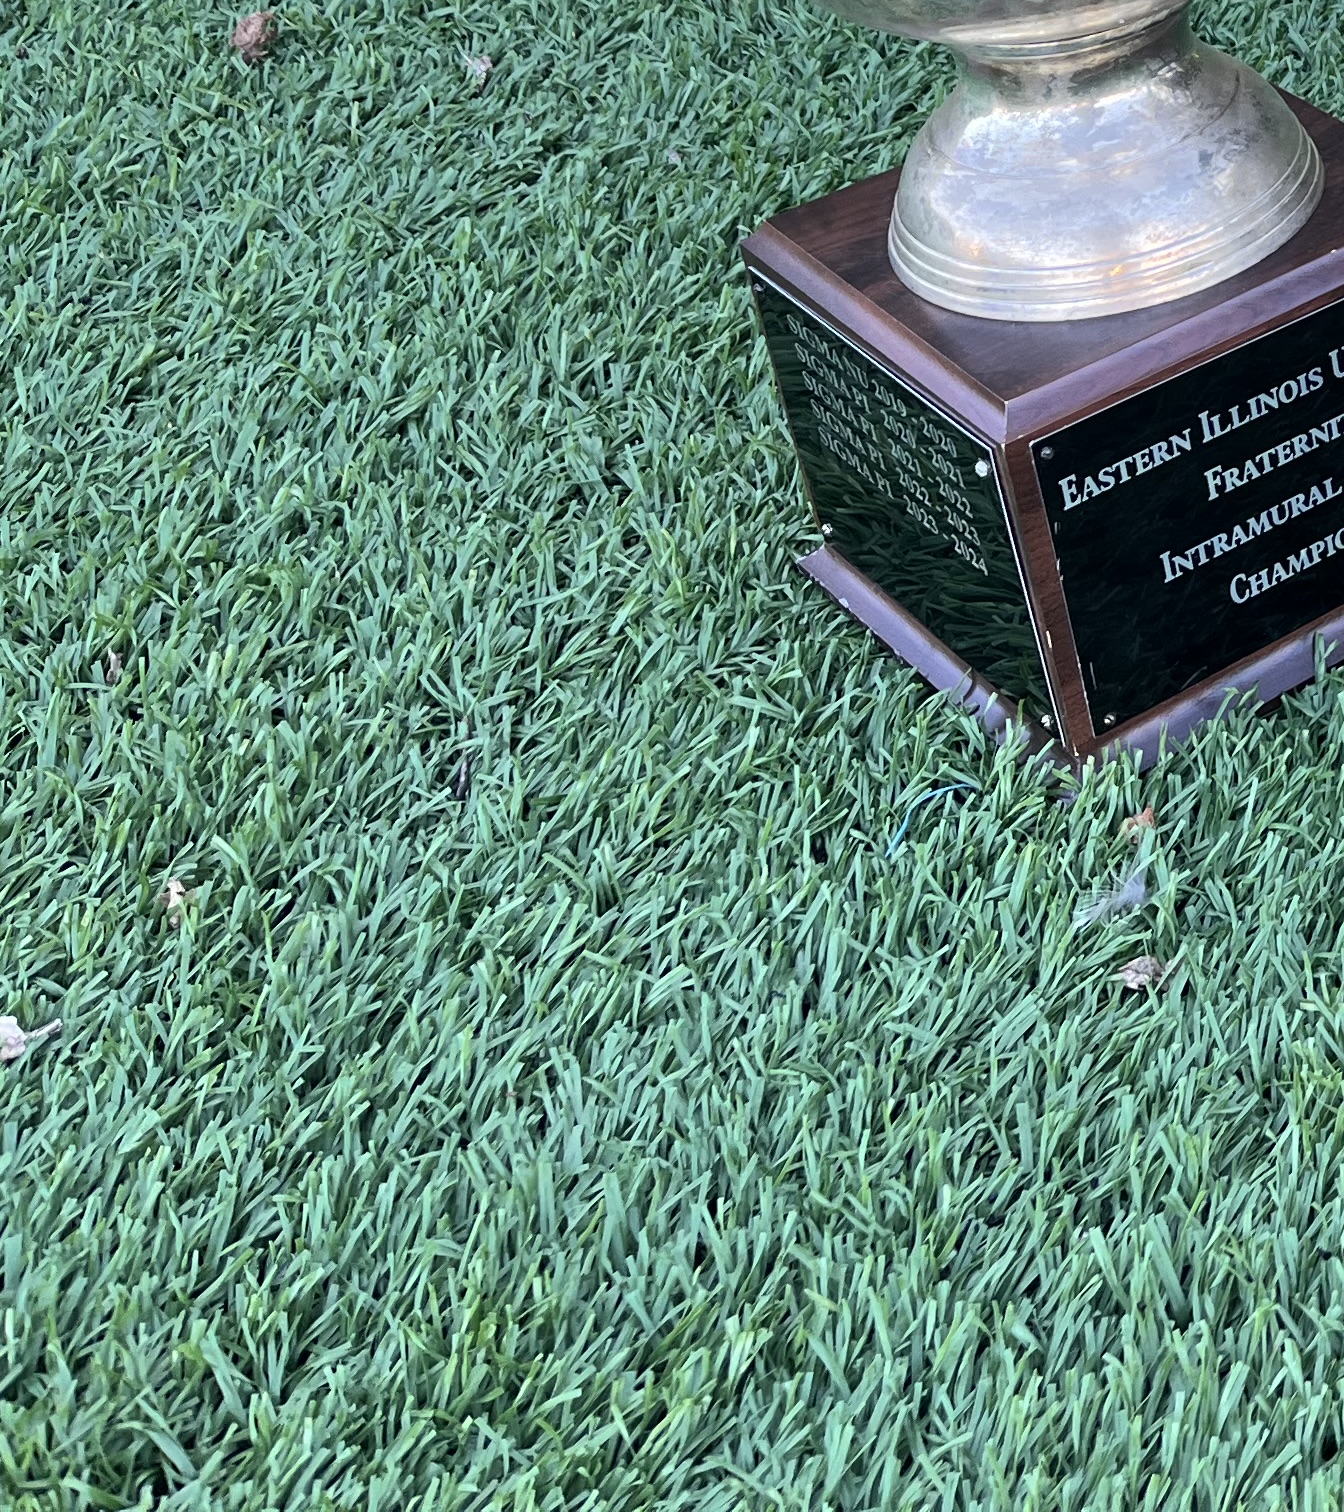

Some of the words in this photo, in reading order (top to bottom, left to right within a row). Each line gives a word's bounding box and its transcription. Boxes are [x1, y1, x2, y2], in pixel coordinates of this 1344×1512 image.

[785, 313, 844, 371] SIGMA
[841, 355, 869, 389] NU
[870, 378, 907, 417] 2019
[918, 415, 957, 458] 2020
[793, 341, 852, 399] SIGMA
[850, 385, 872, 414] PI
[879, 408, 916, 449] 2020
[927, 446, 966, 489] 2021
[801, 370, 859, 428] SIGMA
[857, 413, 879, 443] PI
[886, 437, 924, 479] 2021
[935, 475, 973, 519] 2022
[809, 398, 867, 455] SIGMA
[865, 441, 887, 471] PI
[894, 466, 932, 507] 2022
[943, 504, 980, 546] 2023
[817, 425, 875, 484] SIGMA
[873, 469, 894, 500] PI
[902, 493, 939, 534] 2023
[950, 533, 988, 576] 2024
